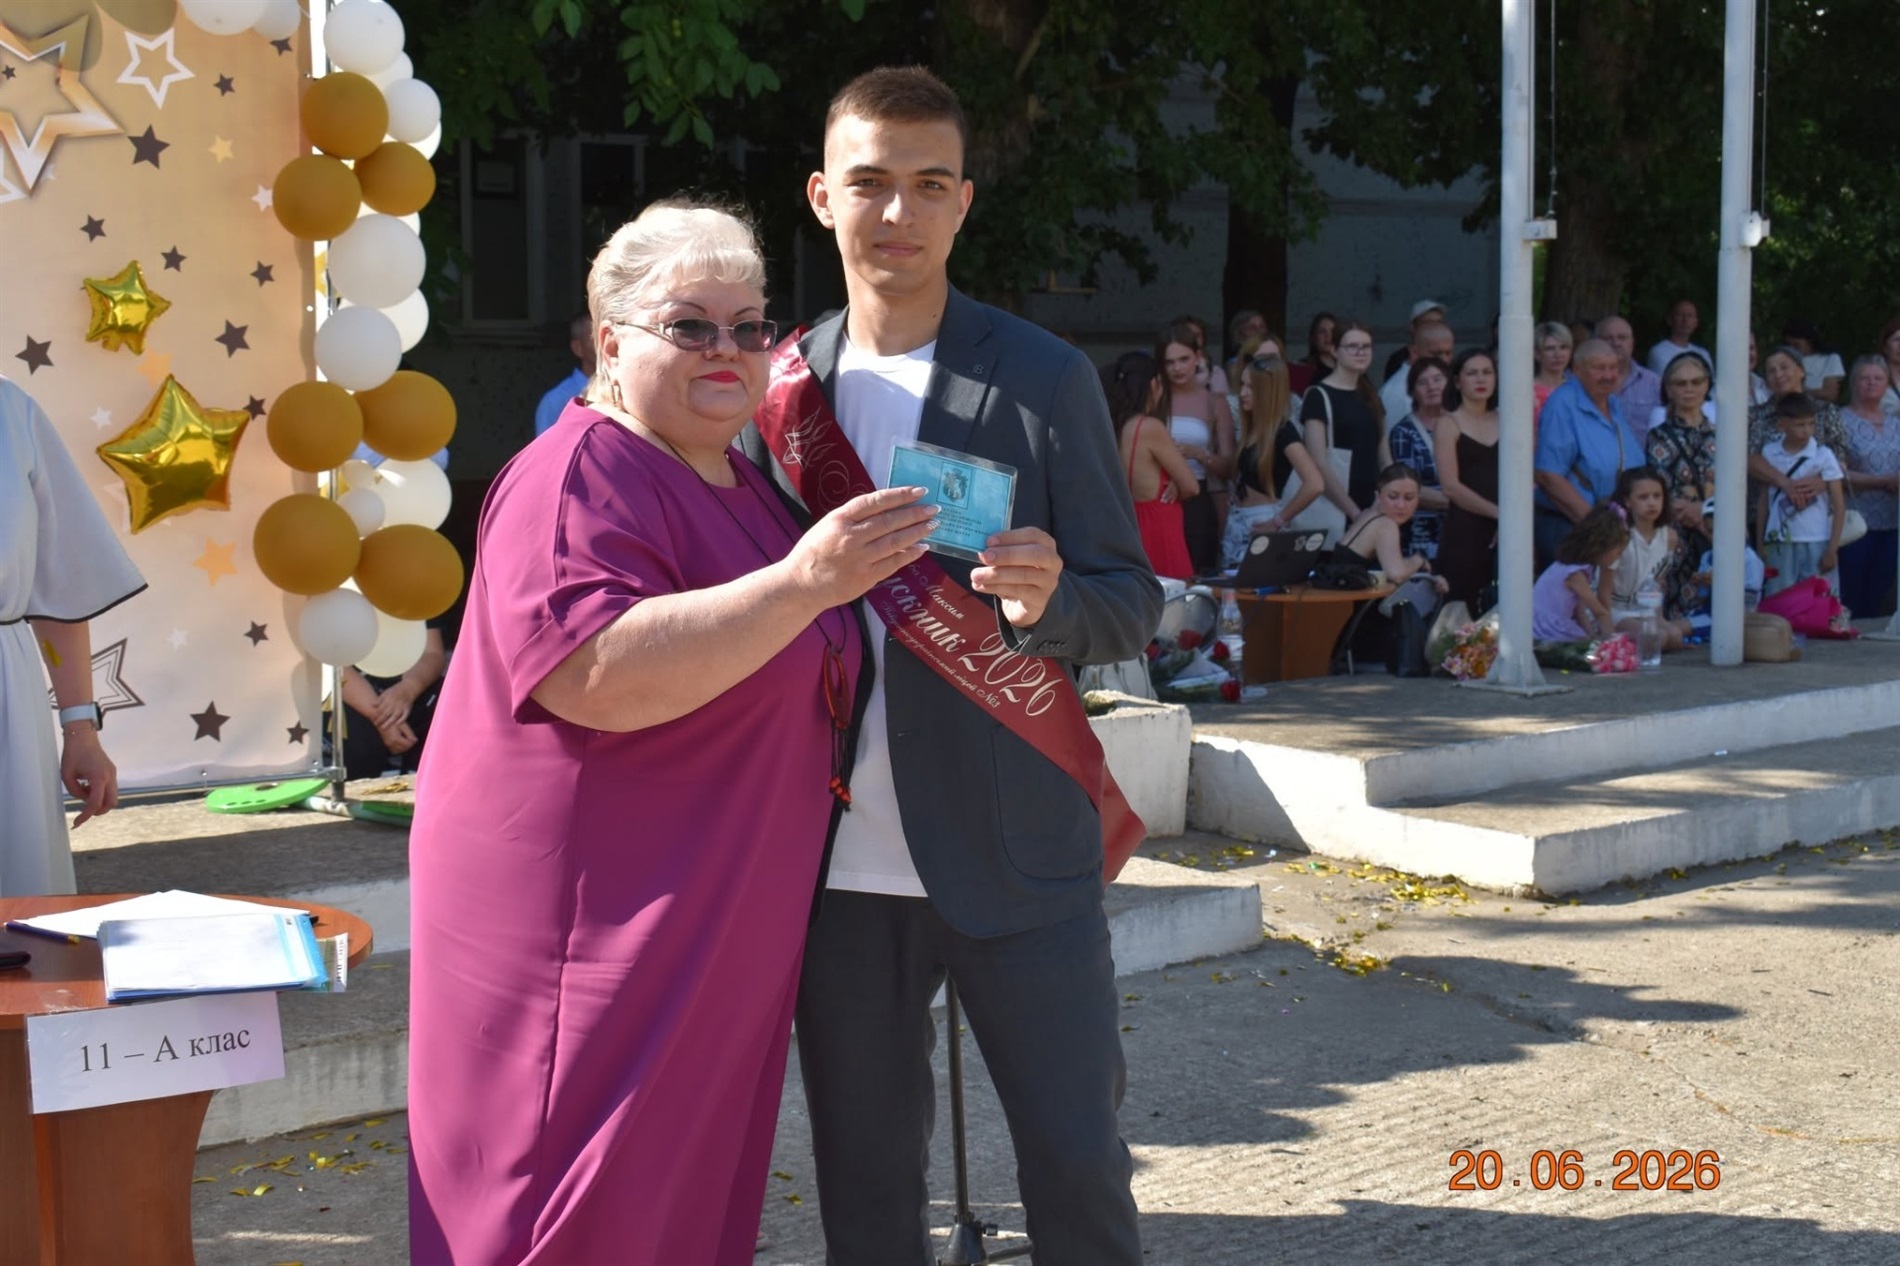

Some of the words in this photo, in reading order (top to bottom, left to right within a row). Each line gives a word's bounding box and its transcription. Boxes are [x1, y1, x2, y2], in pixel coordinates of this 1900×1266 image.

[919, 575, 965, 620] Максим
[957, 632, 1063, 716] 2026
[80, 1042, 112, 1072] 11
[153, 1034, 180, 1063] А
[188, 1028, 251, 1058] клас
